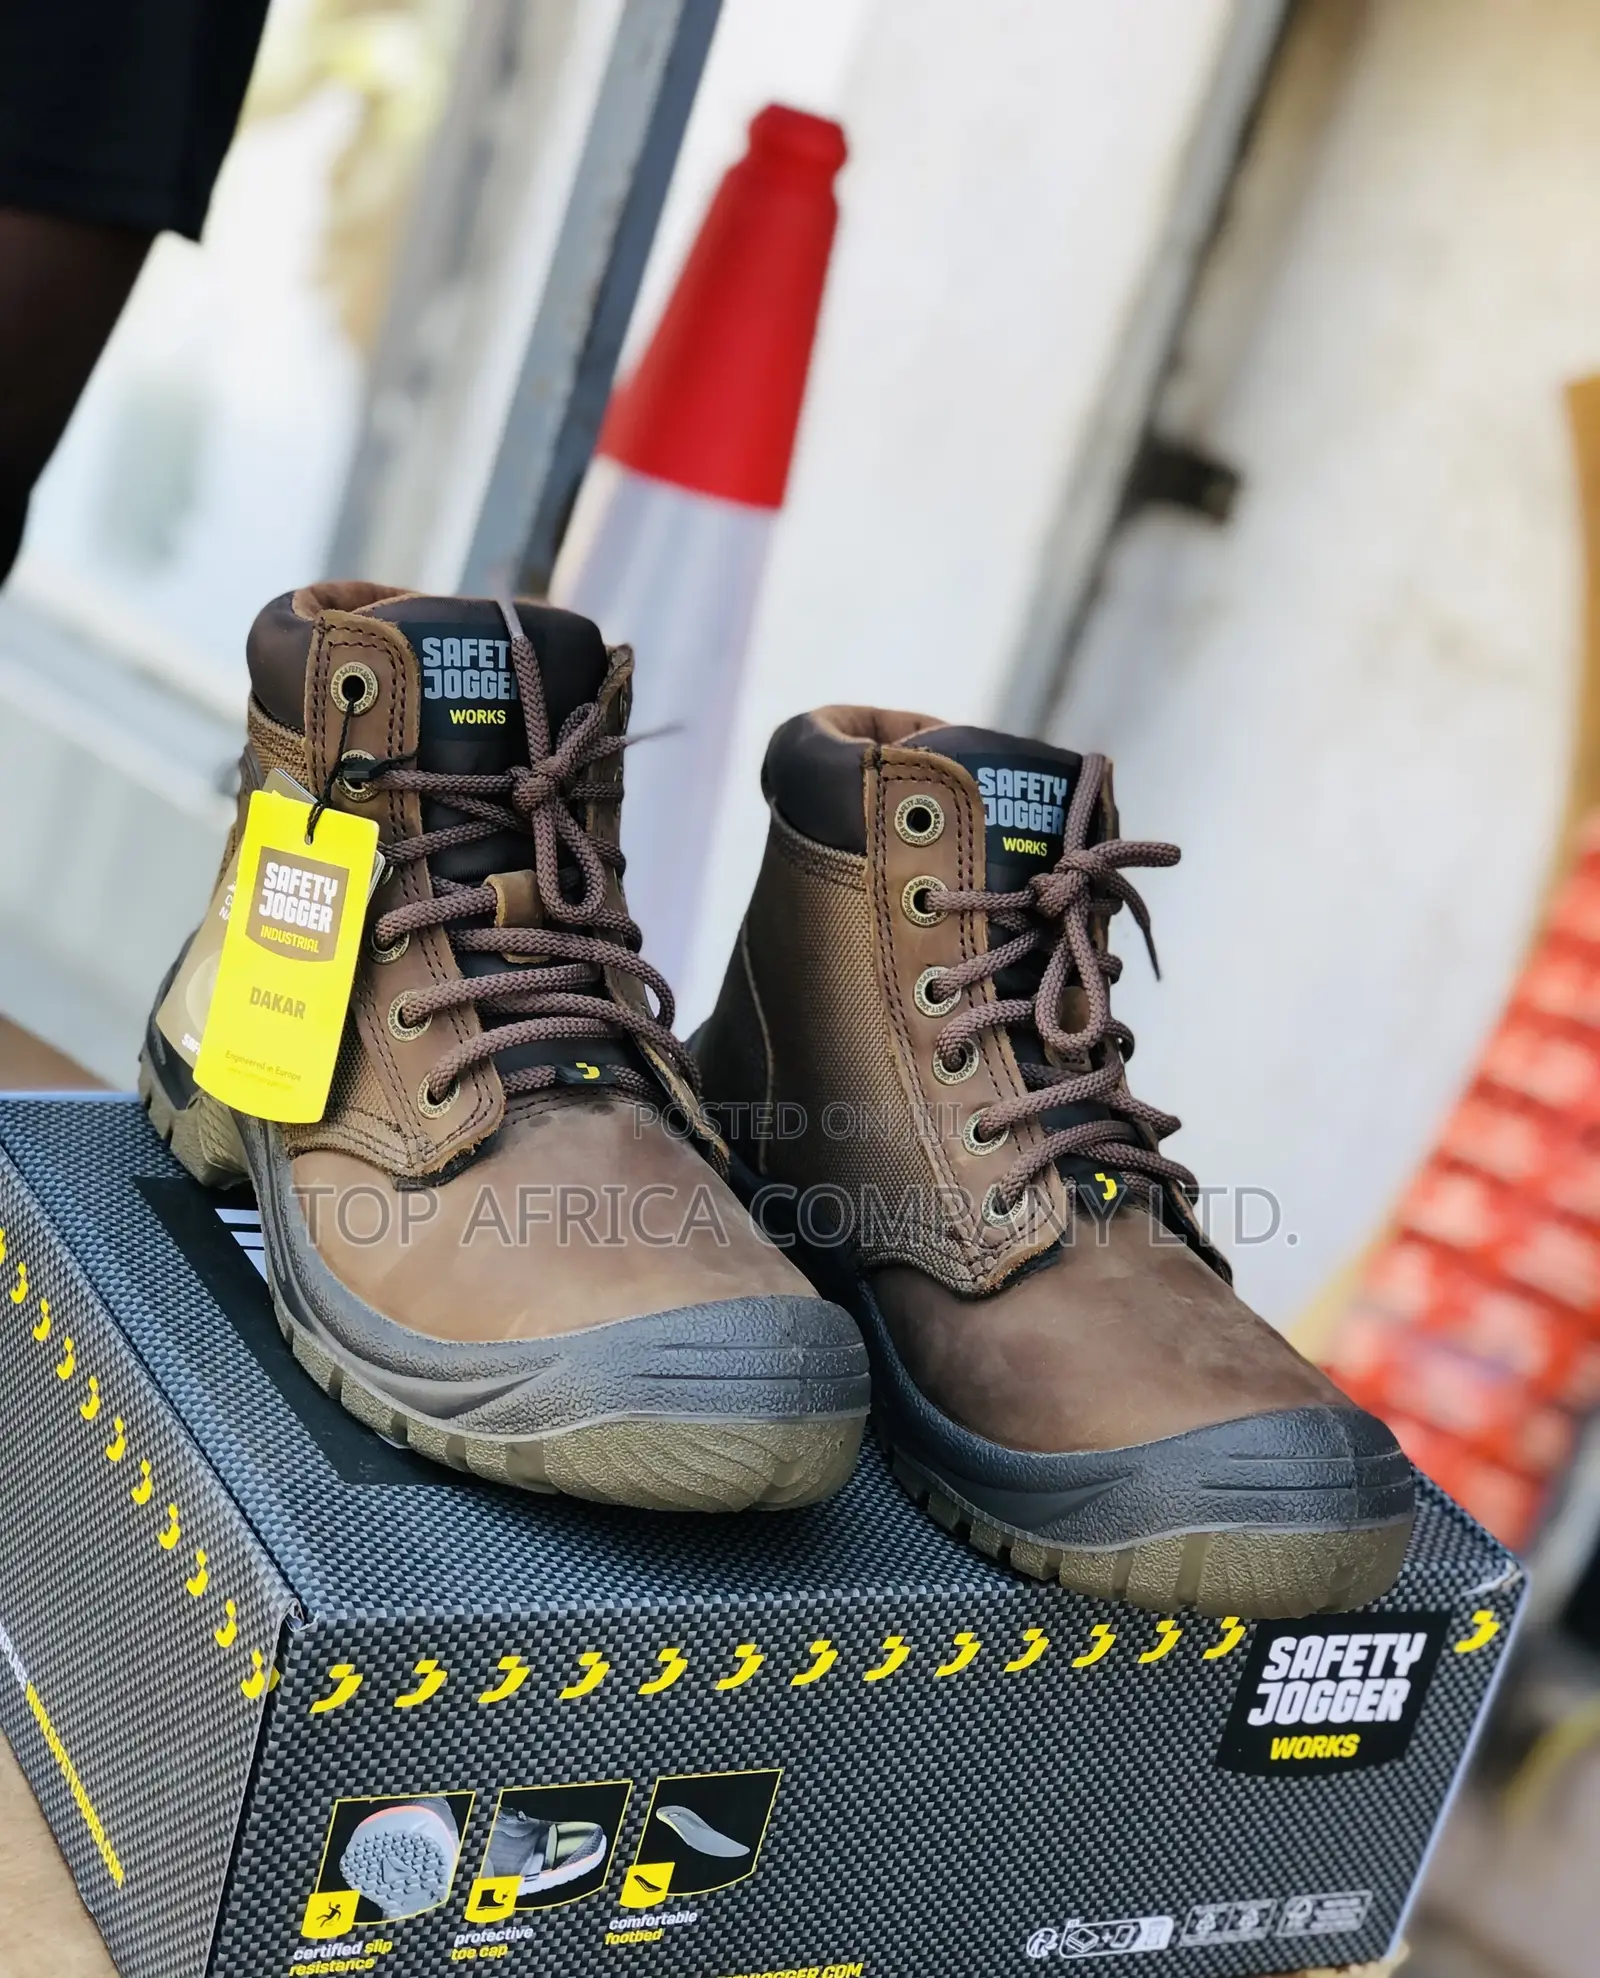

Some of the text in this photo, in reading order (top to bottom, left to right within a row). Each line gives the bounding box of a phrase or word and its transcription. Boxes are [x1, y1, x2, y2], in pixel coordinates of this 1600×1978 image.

[423, 637, 511, 669] SAFET
[424, 669, 518, 700] JOGGE
[450, 709, 507, 725] WORKS
[977, 767, 1067, 806] SAFETY
[984, 797, 1065, 835] JOGGER
[1003, 837, 1048, 857] WORKS
[264, 862, 338, 905] SAFETY
[259, 888, 333, 934] JOGGER
[260, 924, 319, 954] INDUSTRIAL
[250, 986, 306, 1019] DAKAR
[1262, 1632, 1428, 1681] SAFETY
[1247, 1678, 1412, 1726] JOGGER
[1270, 1733, 1361, 1760] WORKS
[609, 1911, 698, 1930] comfortable
[293, 1938, 393, 1961] certified slip
[451, 1943, 508, 1960] toe cap
[455, 1926, 536, 1947] protective
[605, 1928, 663, 1945] footbed
[288, 1957, 375, 1977] resistance
